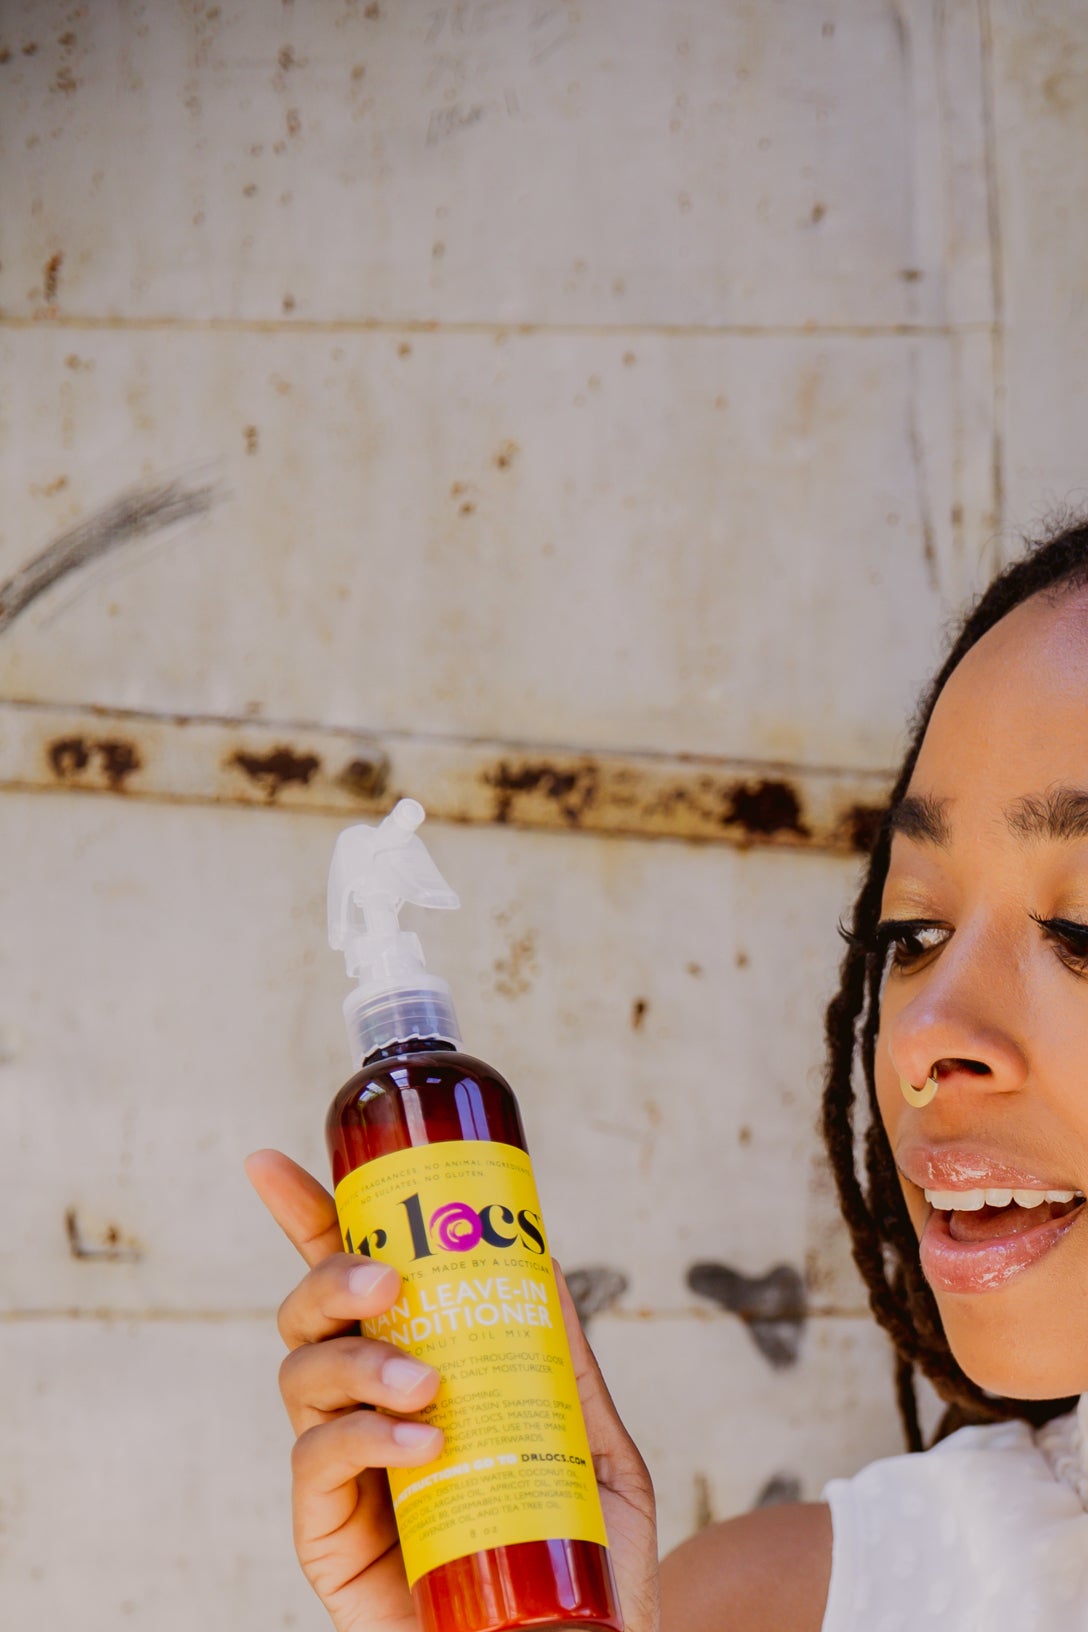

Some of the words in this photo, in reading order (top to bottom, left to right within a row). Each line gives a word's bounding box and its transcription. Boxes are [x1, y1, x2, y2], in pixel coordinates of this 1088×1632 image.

[425, 1162, 440, 1171] NO
[445, 1159, 481, 1168] ANIMAL
[425, 1173, 440, 1182] NO
[396, 1192, 547, 1262] locs
[432, 1260, 467, 1274] MADE
[472, 1258, 487, 1268] BY
[492, 1257, 501, 1267] A
[419, 1276, 549, 1314] LEAVE-IN
[377, 1302, 554, 1347] NDITIONER
[405, 1335, 457, 1357] ONUT
[468, 1331, 496, 1343] OIL
[504, 1329, 531, 1340] MIX
[437, 1358, 467, 1374] VENLY
[468, 1352, 540, 1365] THROUGHOUT
[460, 1366, 489, 1380] DAILY
[448, 1406, 467, 1418] THE
[521, 1453, 587, 1466] DRLOCS.COM
